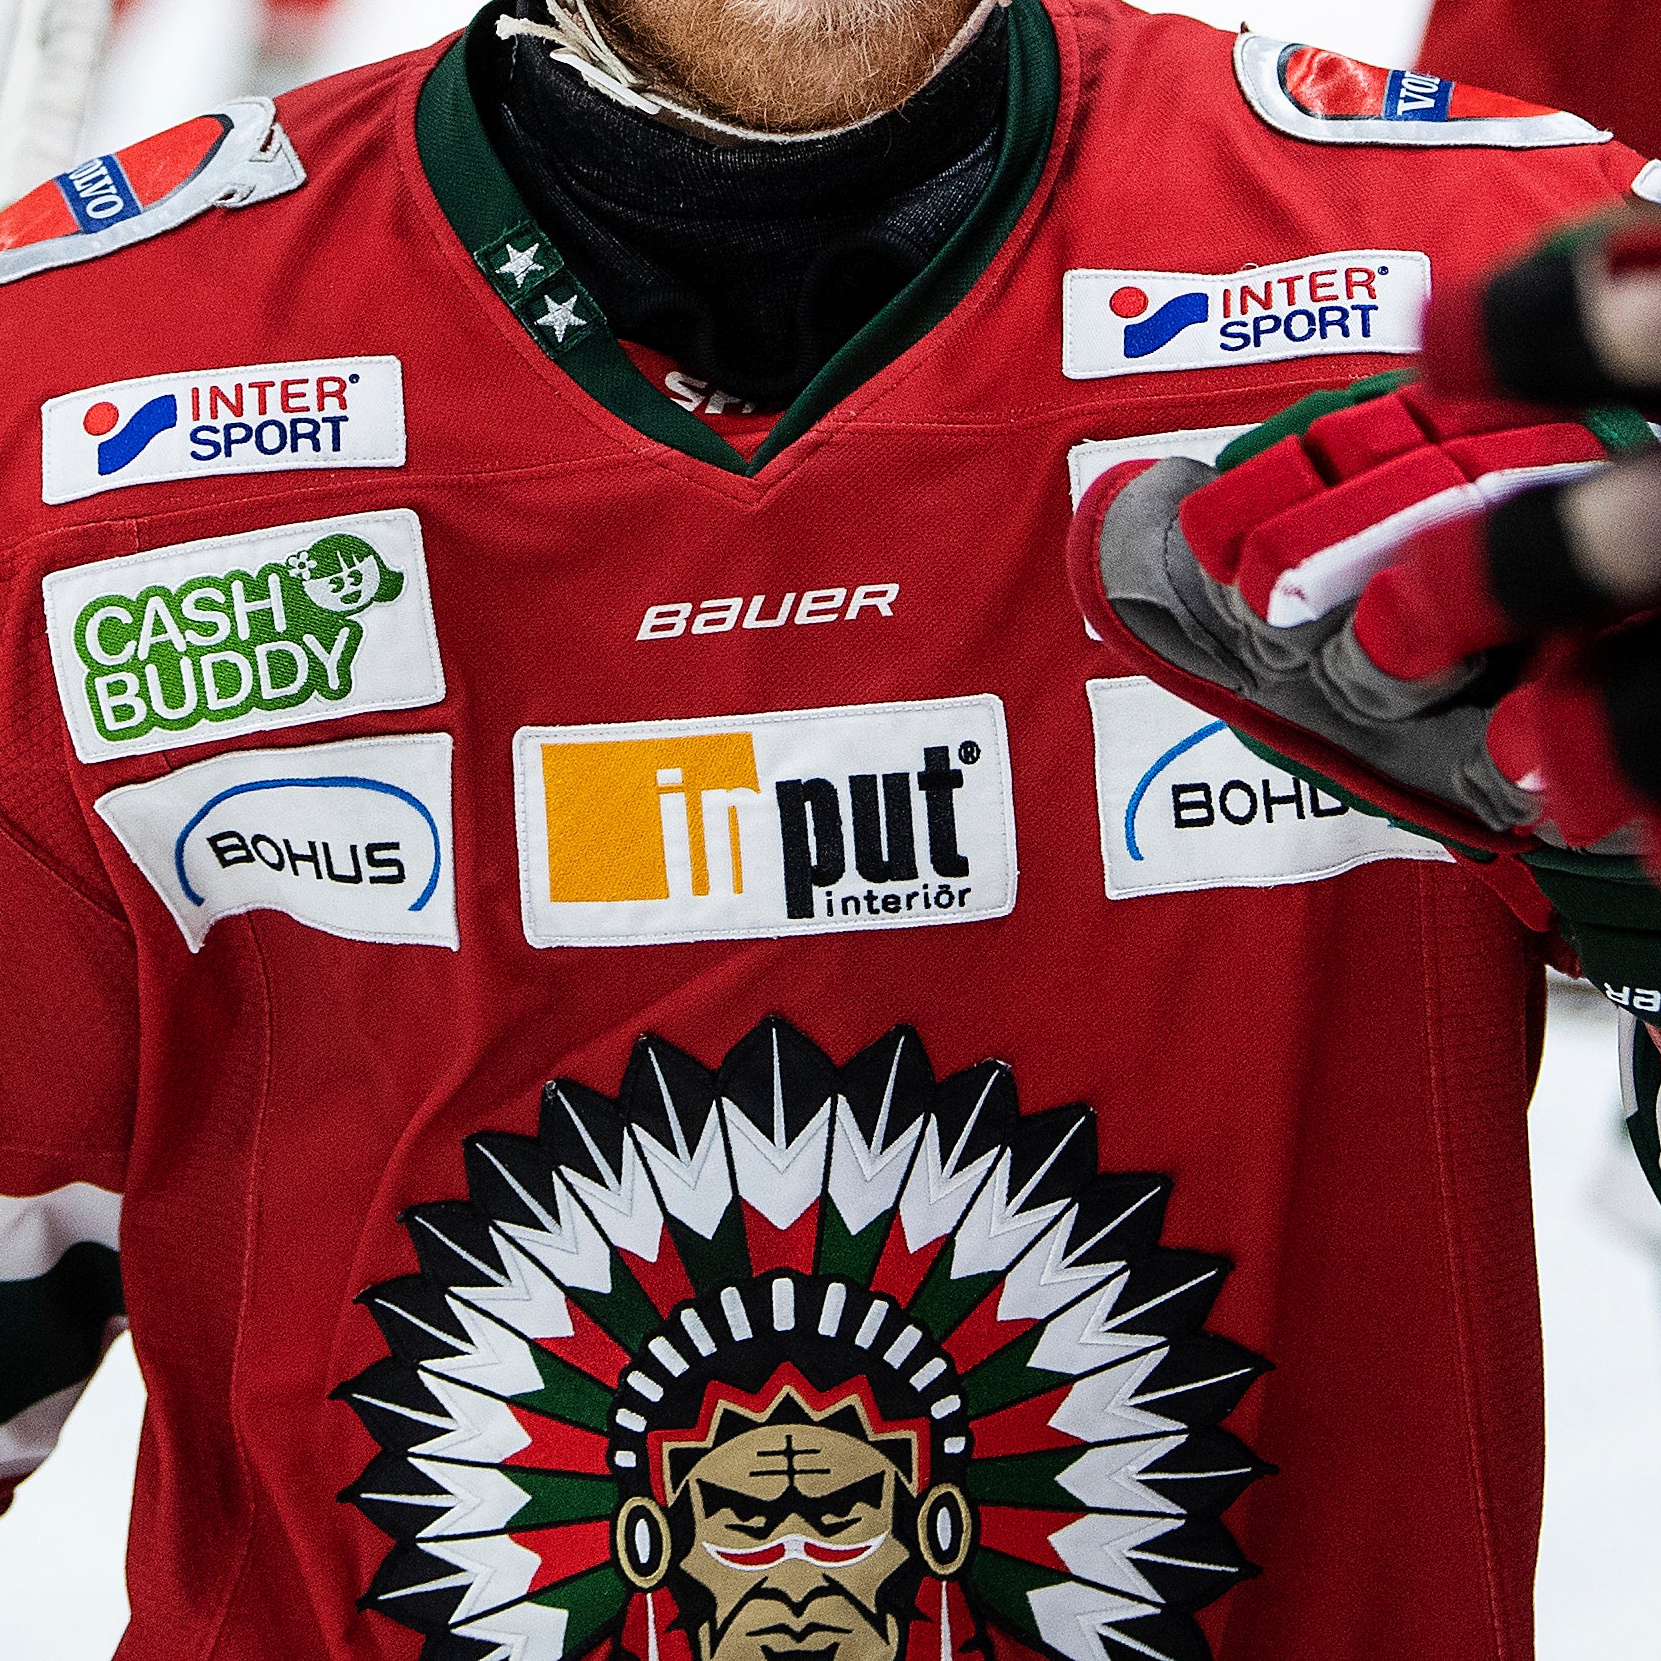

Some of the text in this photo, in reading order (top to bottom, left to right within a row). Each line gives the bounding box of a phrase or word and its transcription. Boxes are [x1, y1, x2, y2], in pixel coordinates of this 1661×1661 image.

[1222, 266, 1377, 319] INTER
[1219, 303, 1379, 352] SPORT
[191, 375, 348, 422] INTER
[189, 415, 350, 462] SPORT
[86, 574, 286, 661] CASH
[637, 582, 900, 640] BAUER
[94, 625, 351, 733] BUDDY
[206, 829, 406, 885] BOHUS
